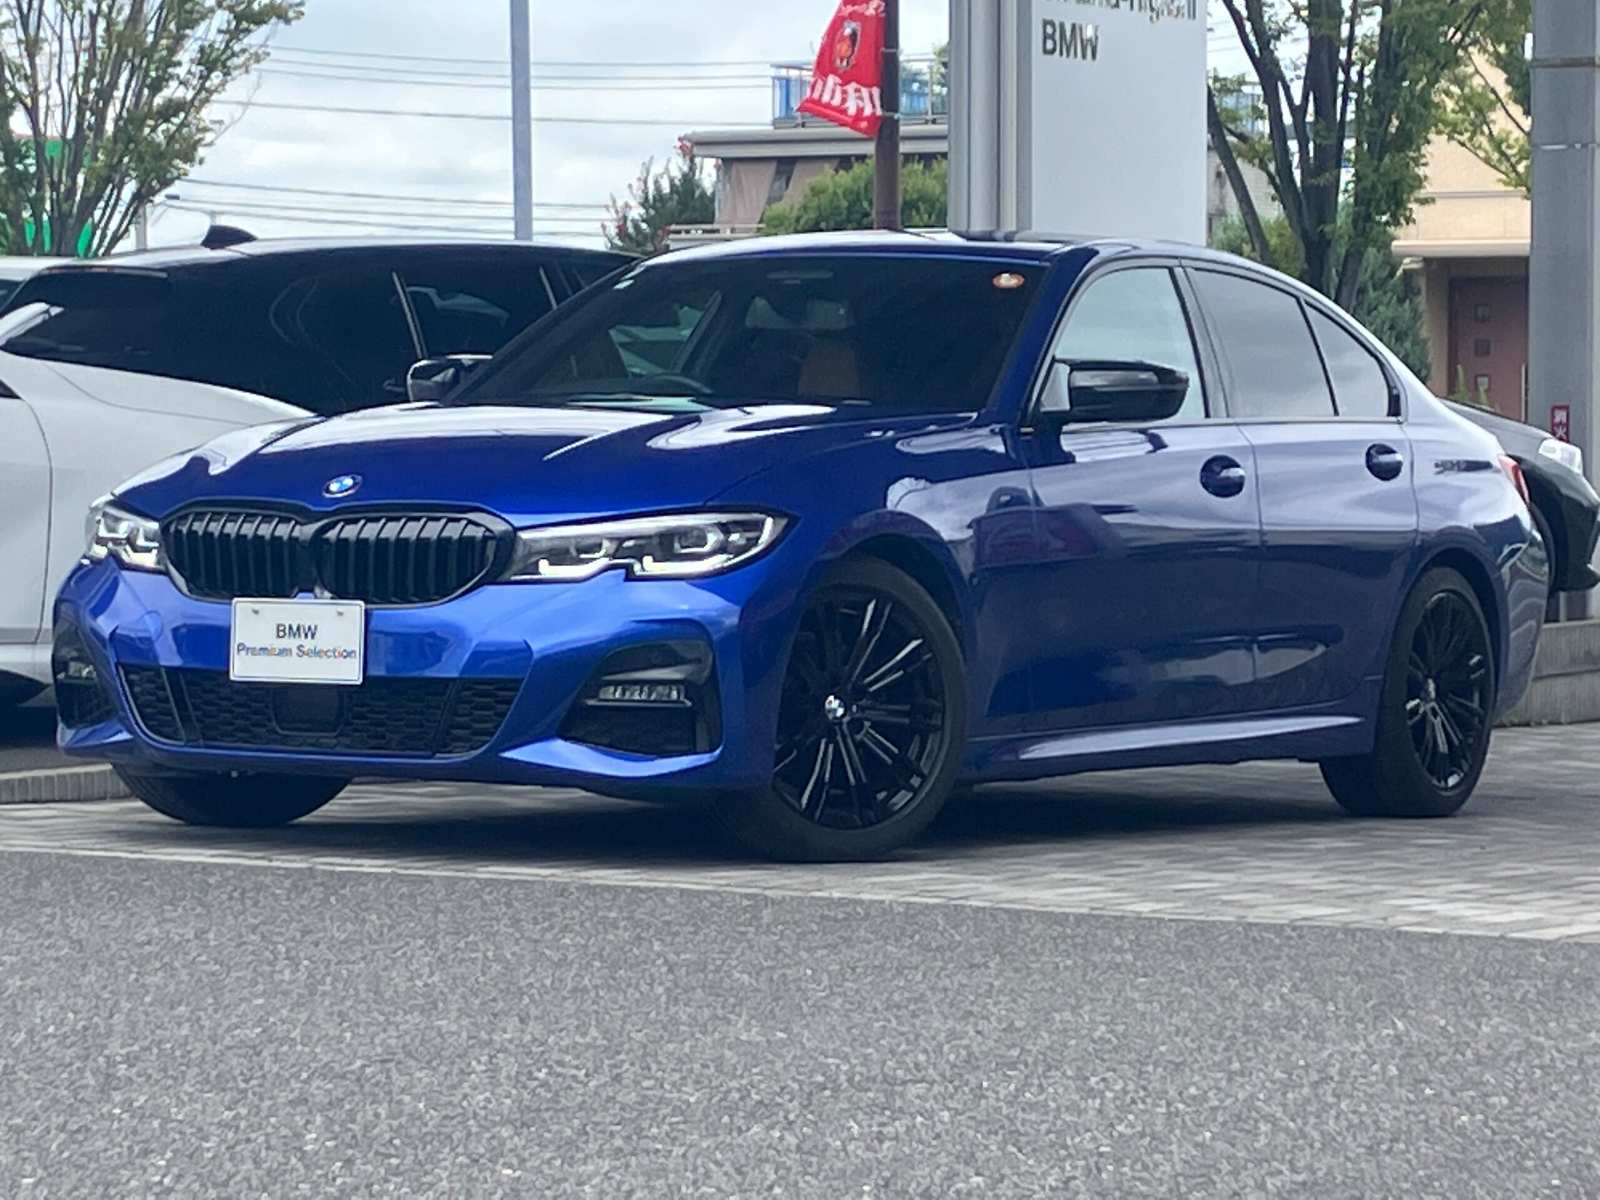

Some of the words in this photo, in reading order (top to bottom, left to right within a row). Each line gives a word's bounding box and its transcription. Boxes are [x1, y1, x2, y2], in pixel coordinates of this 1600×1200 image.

[1041, 18, 1099, 61] BMW
[275, 623, 318, 640] BMW
[236, 642, 293, 658] Premium
[296, 644, 357, 659] Selection
